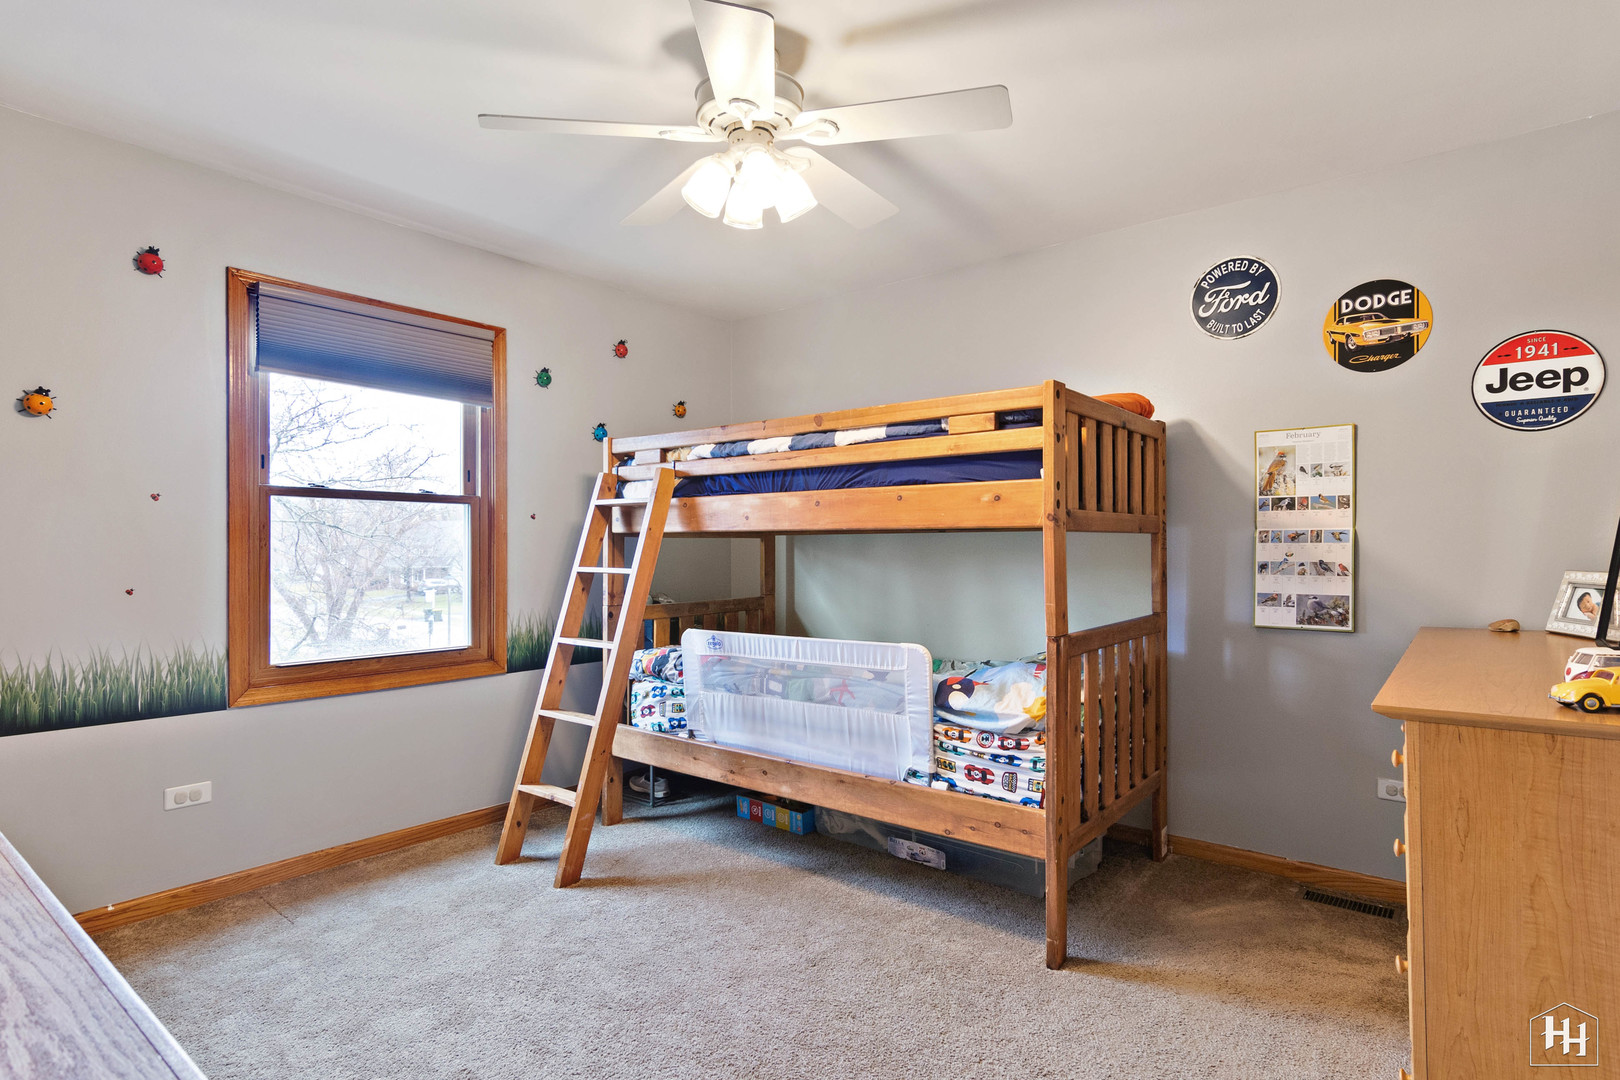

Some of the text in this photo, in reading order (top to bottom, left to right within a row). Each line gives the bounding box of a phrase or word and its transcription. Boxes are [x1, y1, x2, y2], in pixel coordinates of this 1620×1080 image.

[1200, 260, 1266, 289] POWERED BY
[1198, 280, 1271, 318] Ford
[1341, 289, 1412, 314] DODGE
[1206, 308, 1266, 334] BUILT TO LAST
[1526, 336, 1547, 344] SINCE
[1349, 353, 1402, 364] Charger
[1515, 342, 1559, 360] 1941
[1485, 366, 1590, 394] Jeep
[1504, 406, 1569, 418] GUARANTEED
[1285, 431, 1321, 440] February
